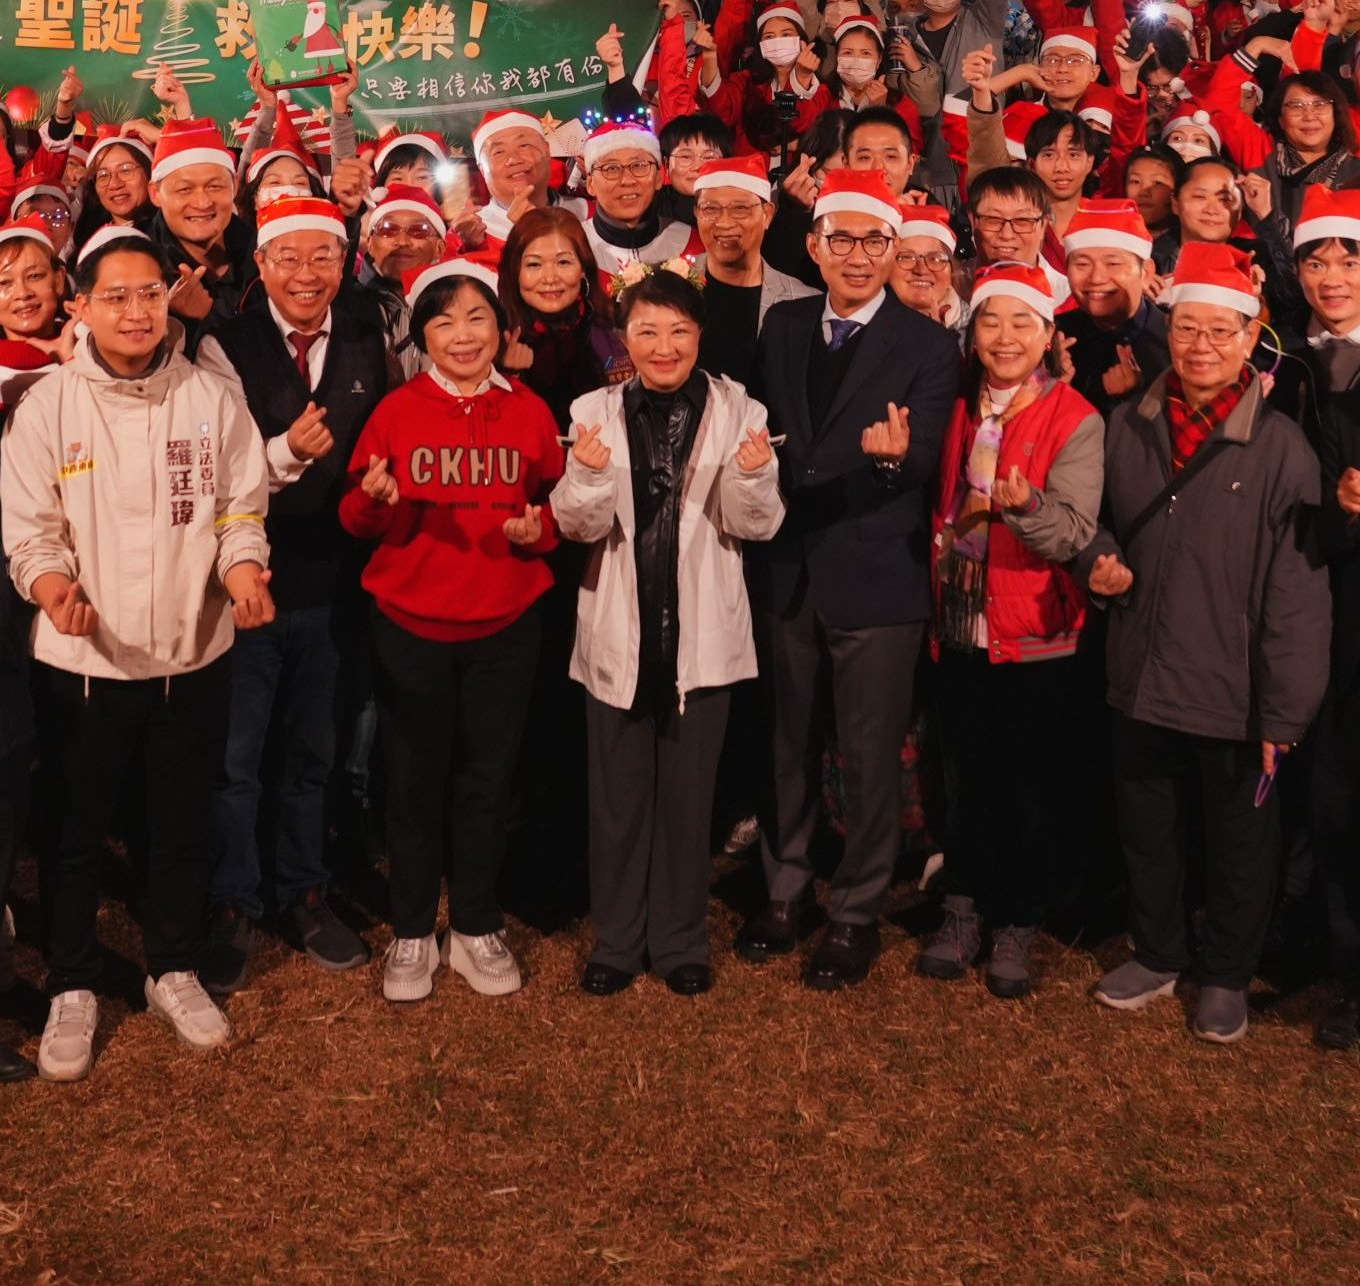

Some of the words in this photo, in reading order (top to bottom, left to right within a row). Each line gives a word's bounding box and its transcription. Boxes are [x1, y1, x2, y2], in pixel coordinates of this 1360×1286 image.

[199, 436, 215, 496] 立法委員
[410, 446, 521, 486] CKHU
